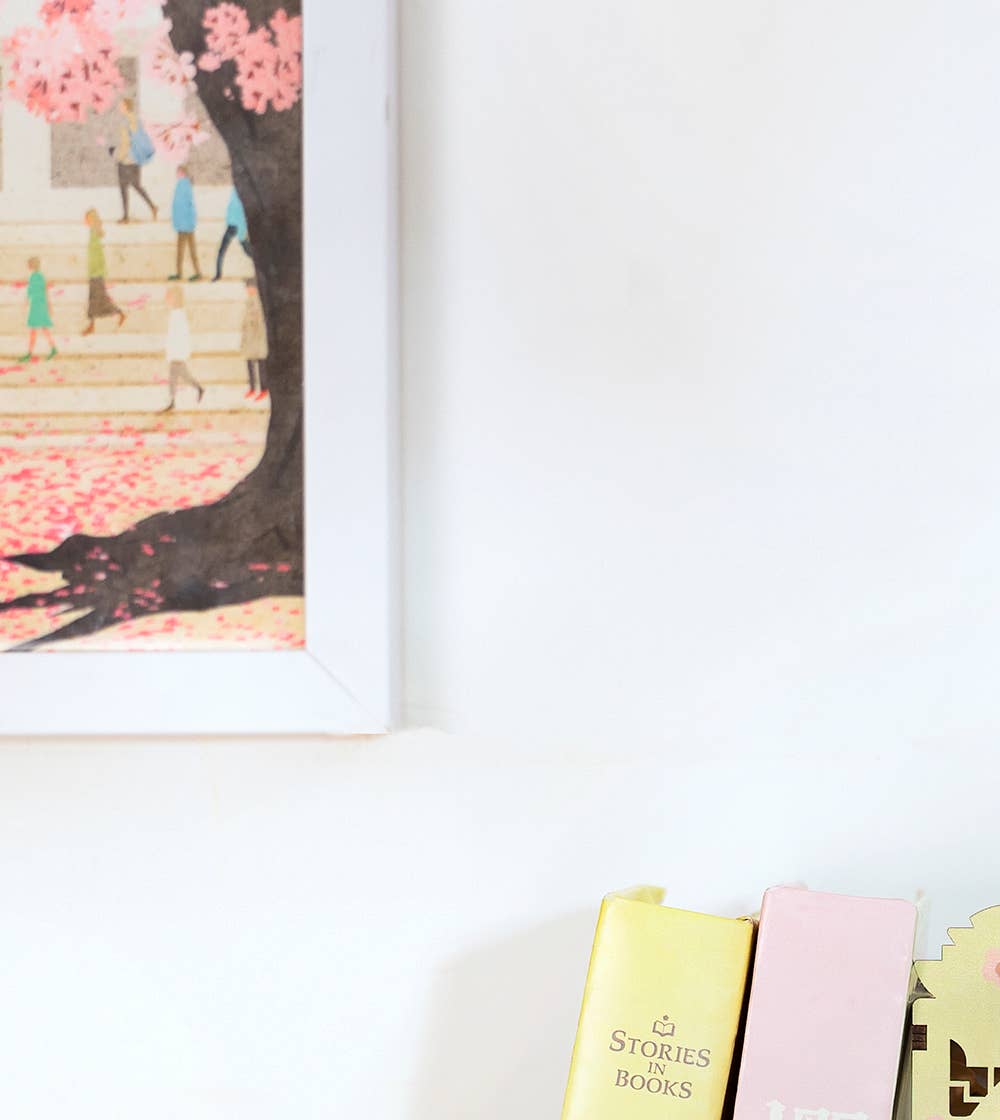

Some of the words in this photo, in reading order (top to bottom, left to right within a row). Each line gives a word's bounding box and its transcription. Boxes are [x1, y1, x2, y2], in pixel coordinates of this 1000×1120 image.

[609, 1030, 711, 1068] STORIES
[648, 1062, 666, 1075] IN
[615, 1069, 693, 1100] BOOKS
